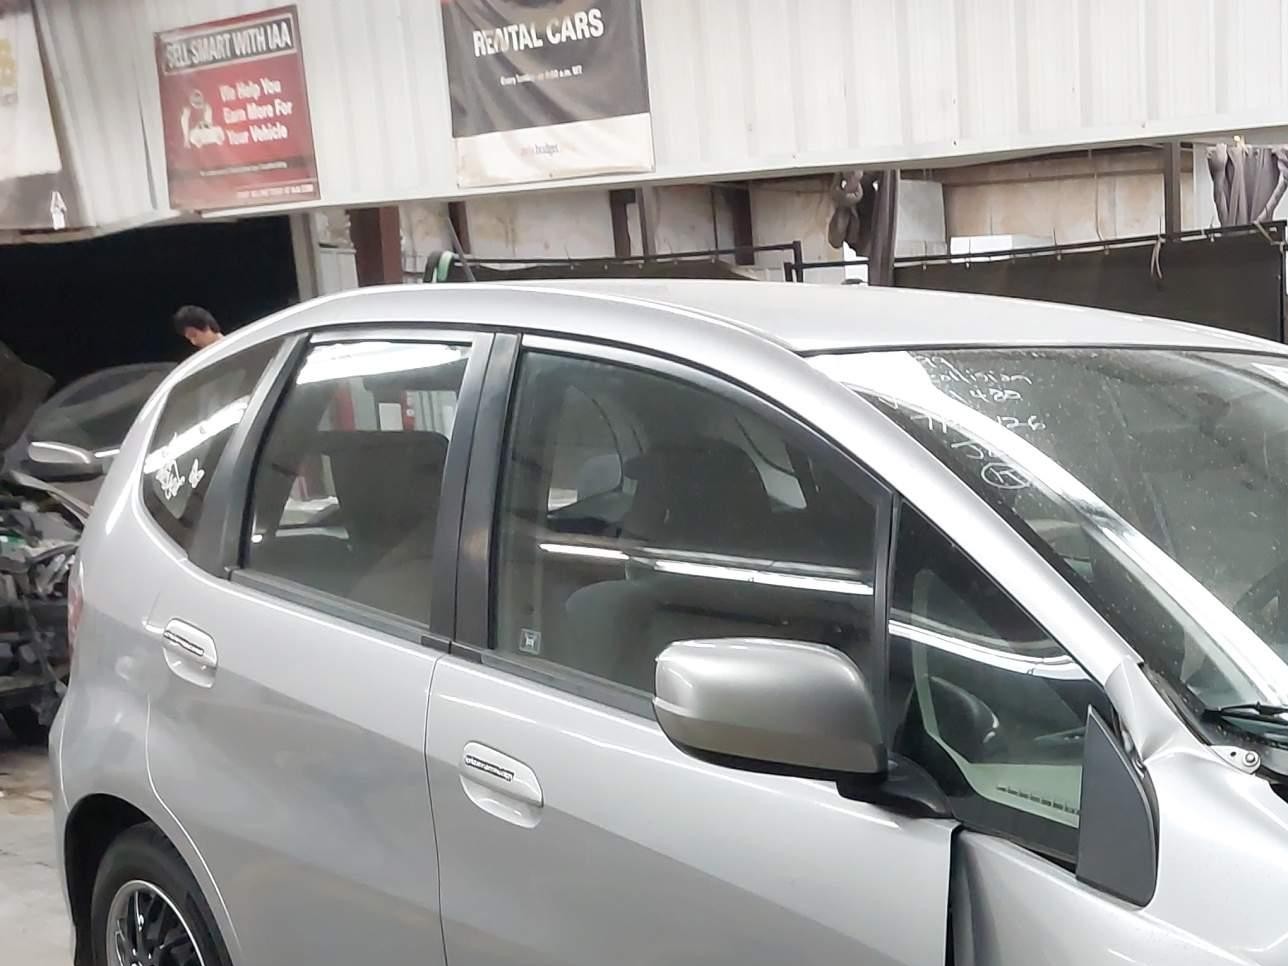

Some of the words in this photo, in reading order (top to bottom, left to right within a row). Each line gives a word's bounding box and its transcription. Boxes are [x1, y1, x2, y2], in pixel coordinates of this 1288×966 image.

[472, 22, 543, 57] RENTAL
[545, 8, 604, 45] CARS
[166, 42, 190, 69] SELL
[190, 34, 231, 63] SMART
[231, 26, 267, 57] WITH
[266, 21, 292, 50] IAA
[235, 80, 260, 101] Help
[259, 77, 282, 95] You
[246, 102, 274, 120] More
[273, 98, 293, 116] For
[248, 121, 288, 143] Vehicle
